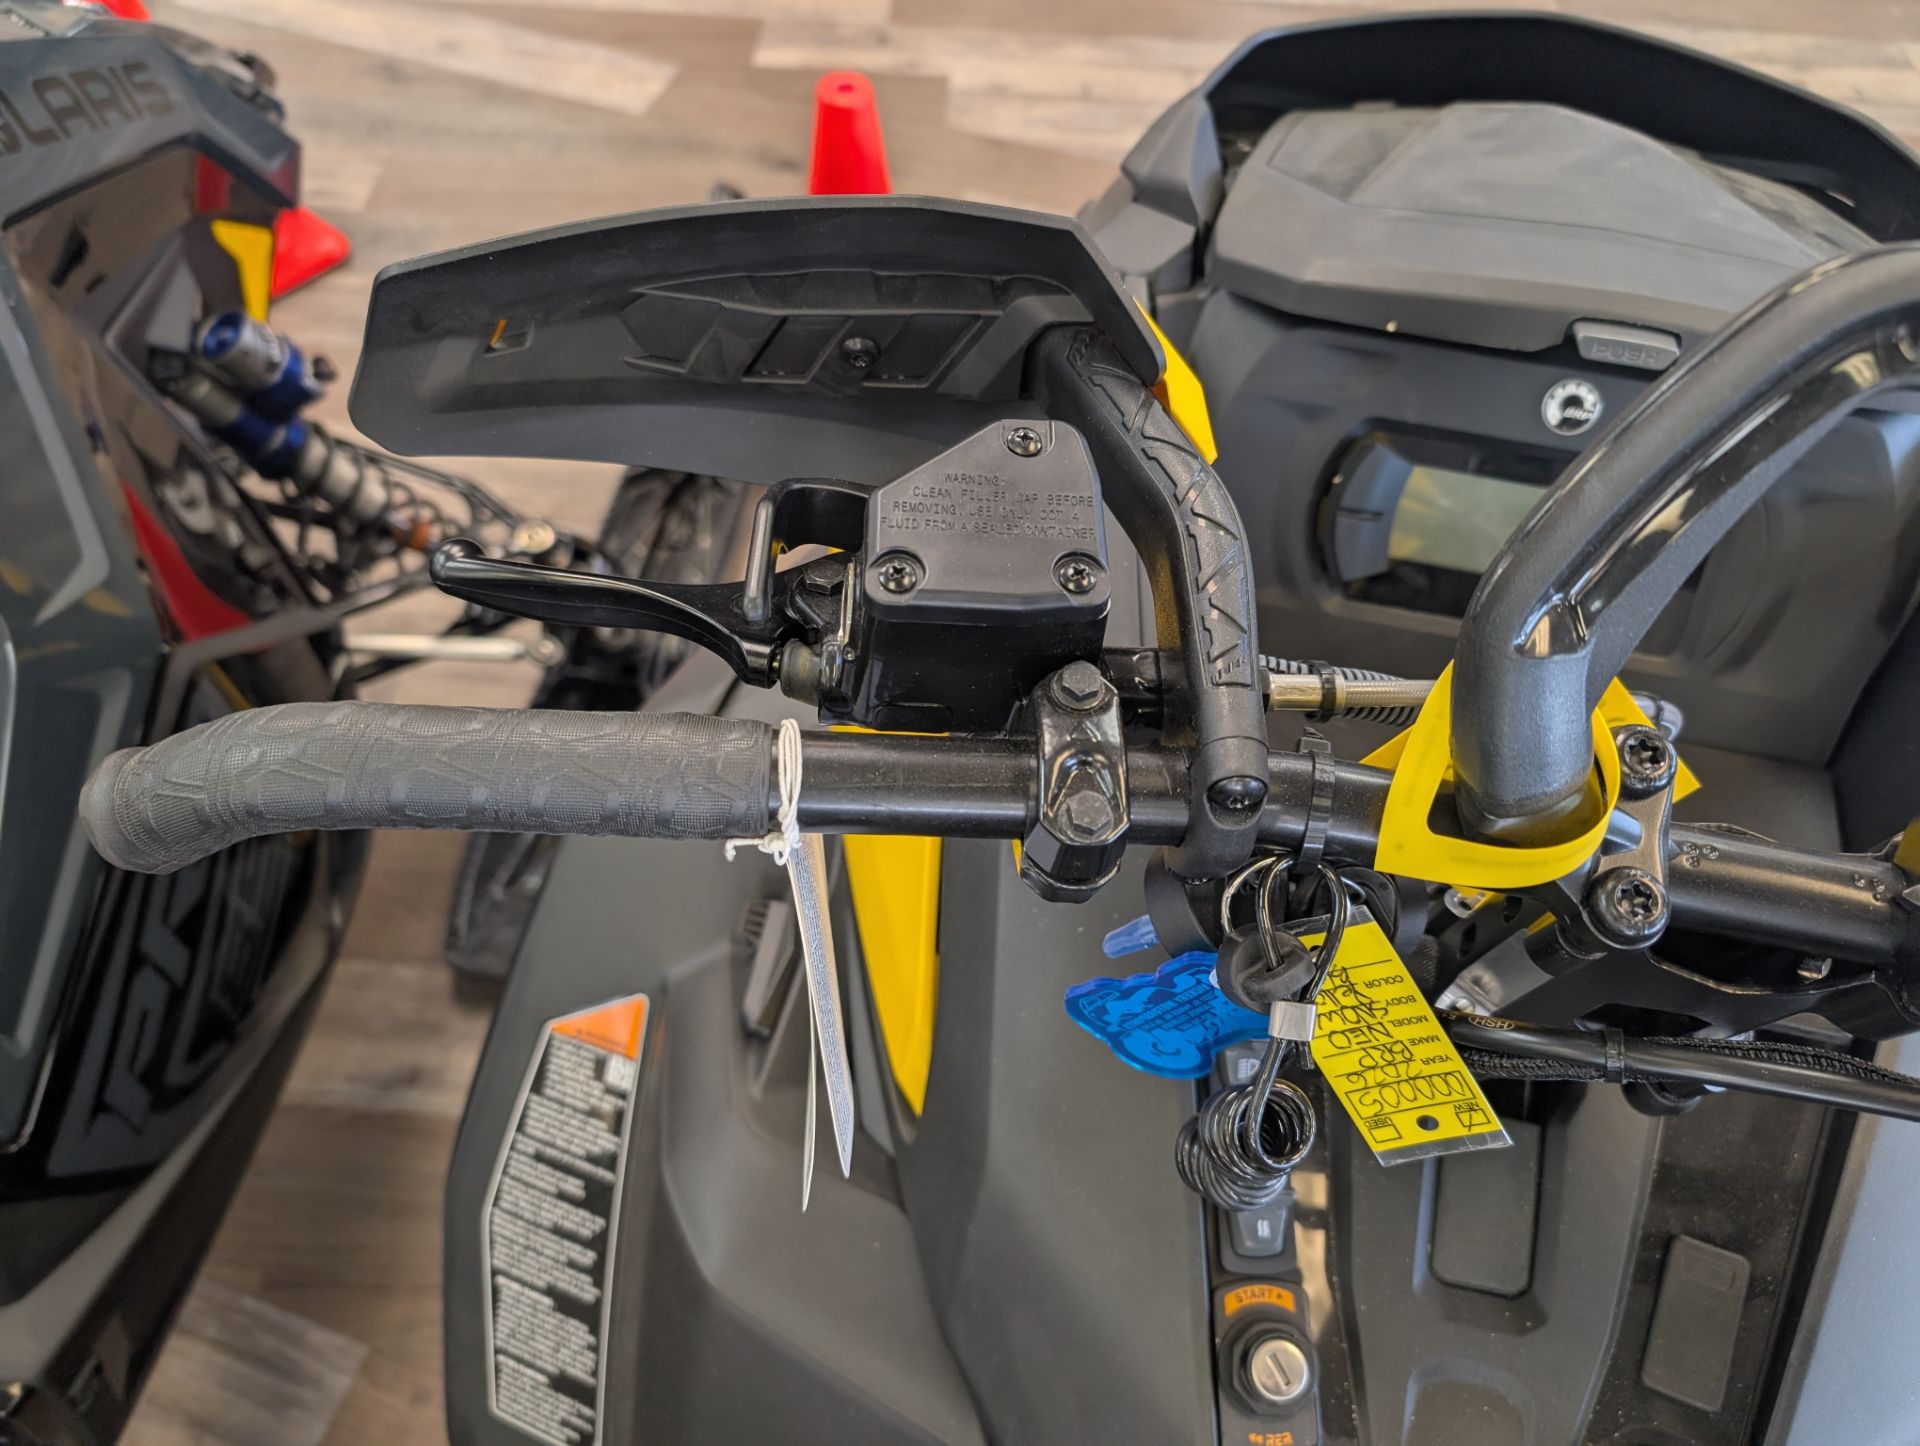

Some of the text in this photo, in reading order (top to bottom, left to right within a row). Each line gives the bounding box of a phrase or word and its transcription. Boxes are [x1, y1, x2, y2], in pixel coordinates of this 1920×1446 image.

[1591, 342, 1657, 366] PUSH
[944, 472, 1005, 487] WARNING:
[913, 486, 1094, 507] CLEAN FILLER CAP BEFORE
[893, 501, 963, 516] REMOVING.
[970, 505, 993, 518] USE
[1000, 506, 1032, 520] ONLY
[1071, 512, 1080, 521] 4
[880, 516, 1097, 541] FLUID FROM A SEALED CONTAINER
[1314, 975, 1404, 1007] COLOR Yello
[1385, 995, 1417, 1008] BODY
[1387, 1014, 1429, 1028] MODEL
[1473, 1016, 1512, 1030] HSH
[1358, 1034, 1441, 1069] MAKE BRP
[1346, 1054, 1454, 1088] YEAR 2026
[1453, 1101, 1480, 1112] NEW
[1363, 1116, 1393, 1128] USED
[1234, 1286, 1273, 1304] START
